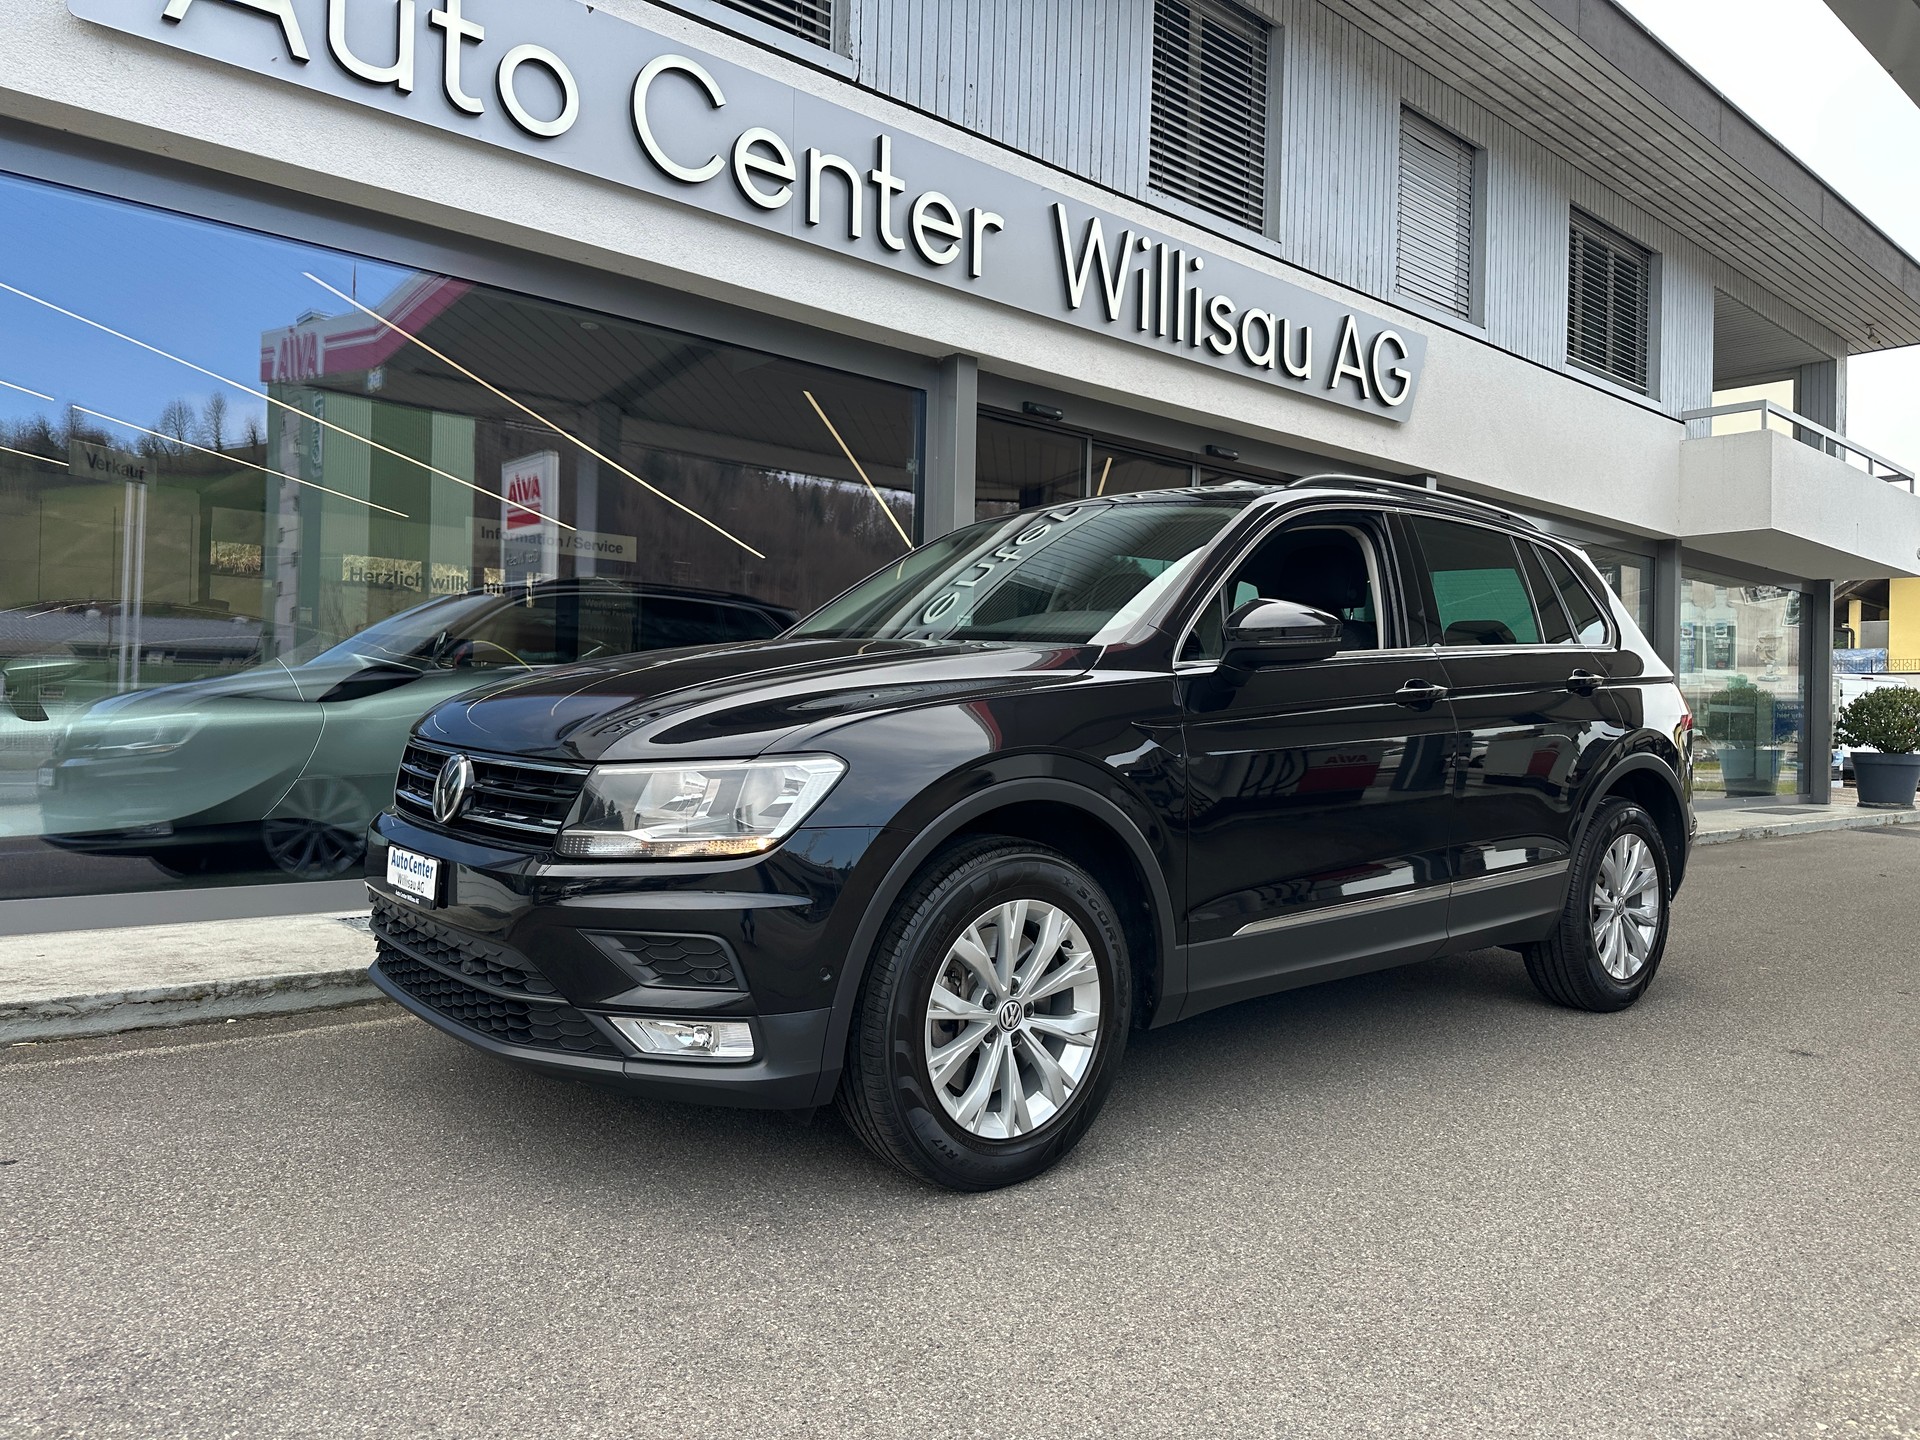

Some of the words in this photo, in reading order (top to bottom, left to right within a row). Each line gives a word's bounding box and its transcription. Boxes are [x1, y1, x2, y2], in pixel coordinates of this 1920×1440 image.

[629, 55, 1004, 279] Center
[1052, 202, 1312, 380] Willisau
[1327, 315, 1412, 407] AG
[481, 526, 564, 548] Information
[574, 537, 624, 554] Service
[350, 567, 426, 588] Herzlich
[416, 881, 425, 894] AG
[1076, 886, 1126, 1008] SCORPION
